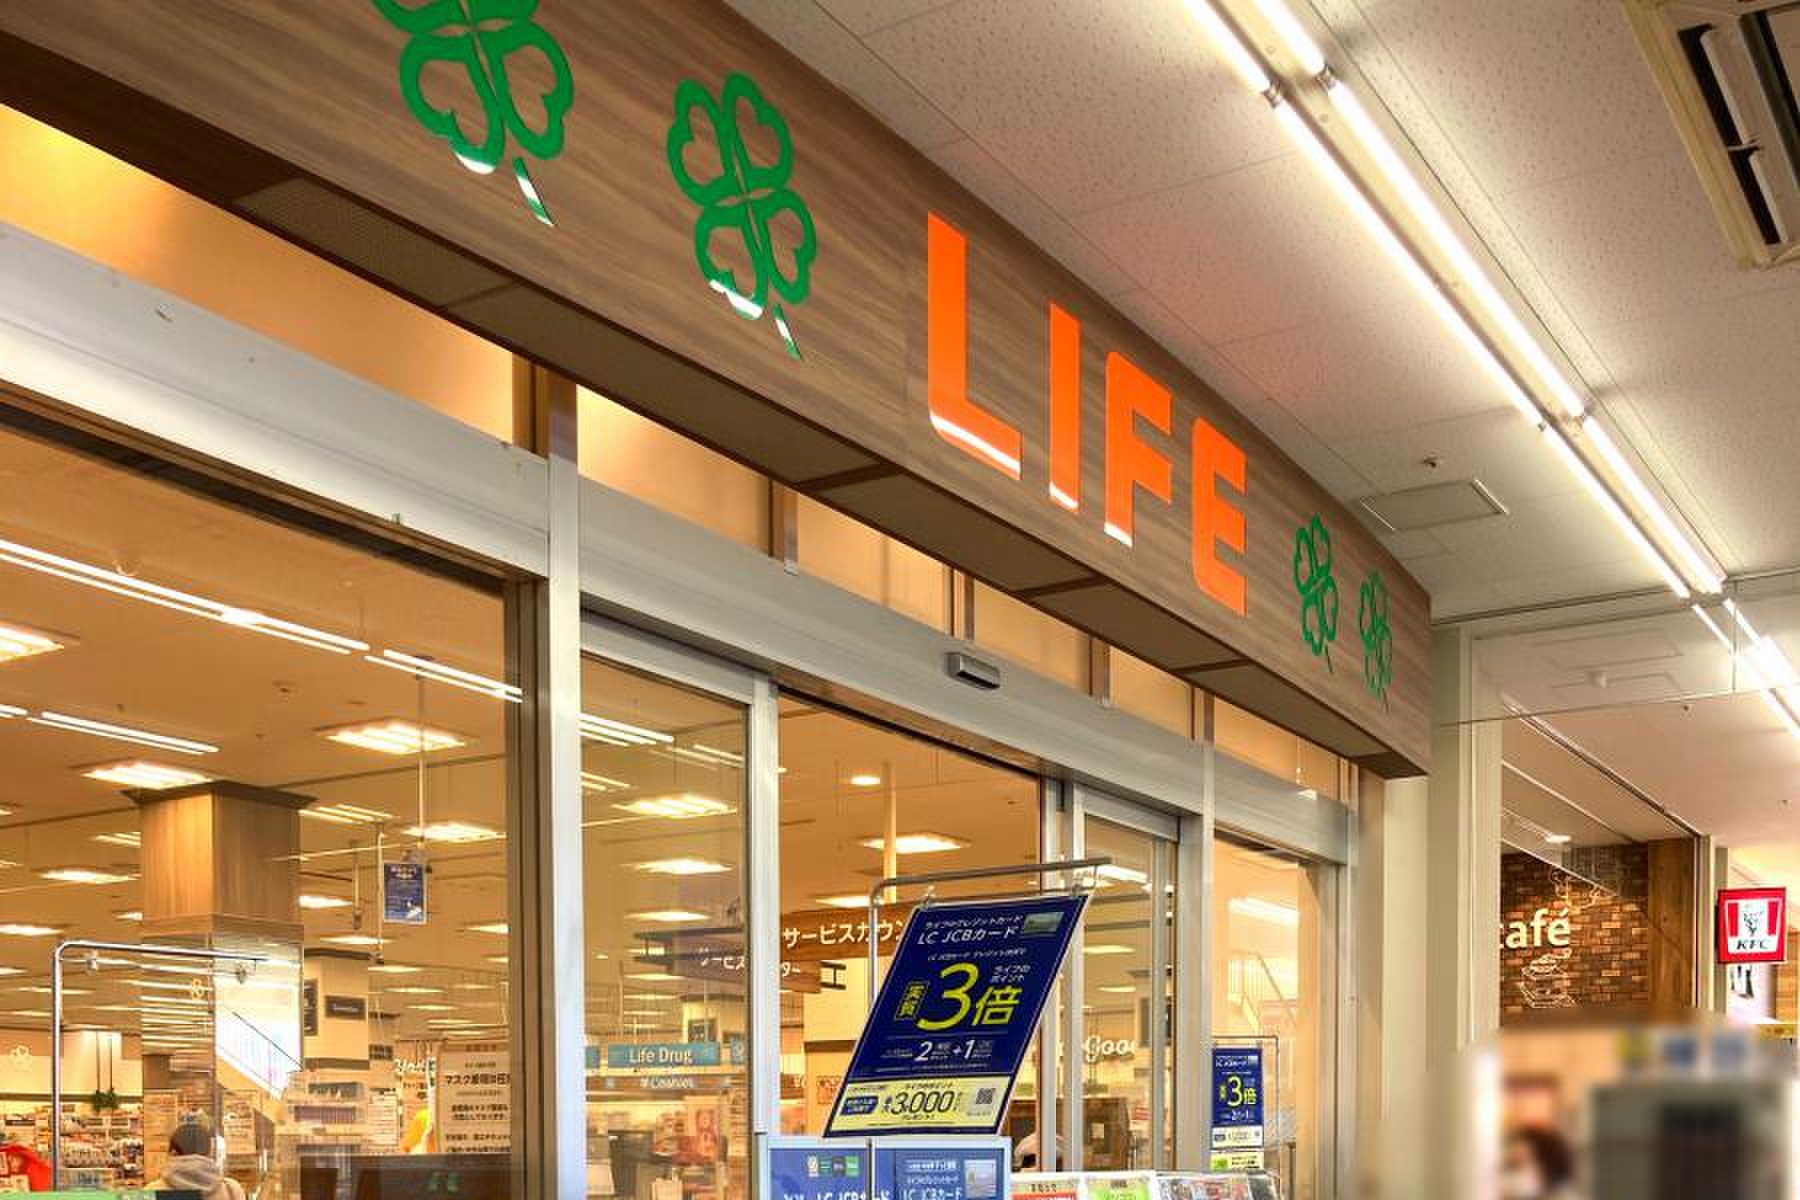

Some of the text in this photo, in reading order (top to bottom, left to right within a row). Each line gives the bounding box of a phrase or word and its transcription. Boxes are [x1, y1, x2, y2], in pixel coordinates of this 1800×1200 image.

[928, 211, 1247, 617] LIFE
[1500, 908, 1570, 949] afé
[1736, 939, 1769, 950] KFC
[629, 1046, 693, 1064] Life Drug
